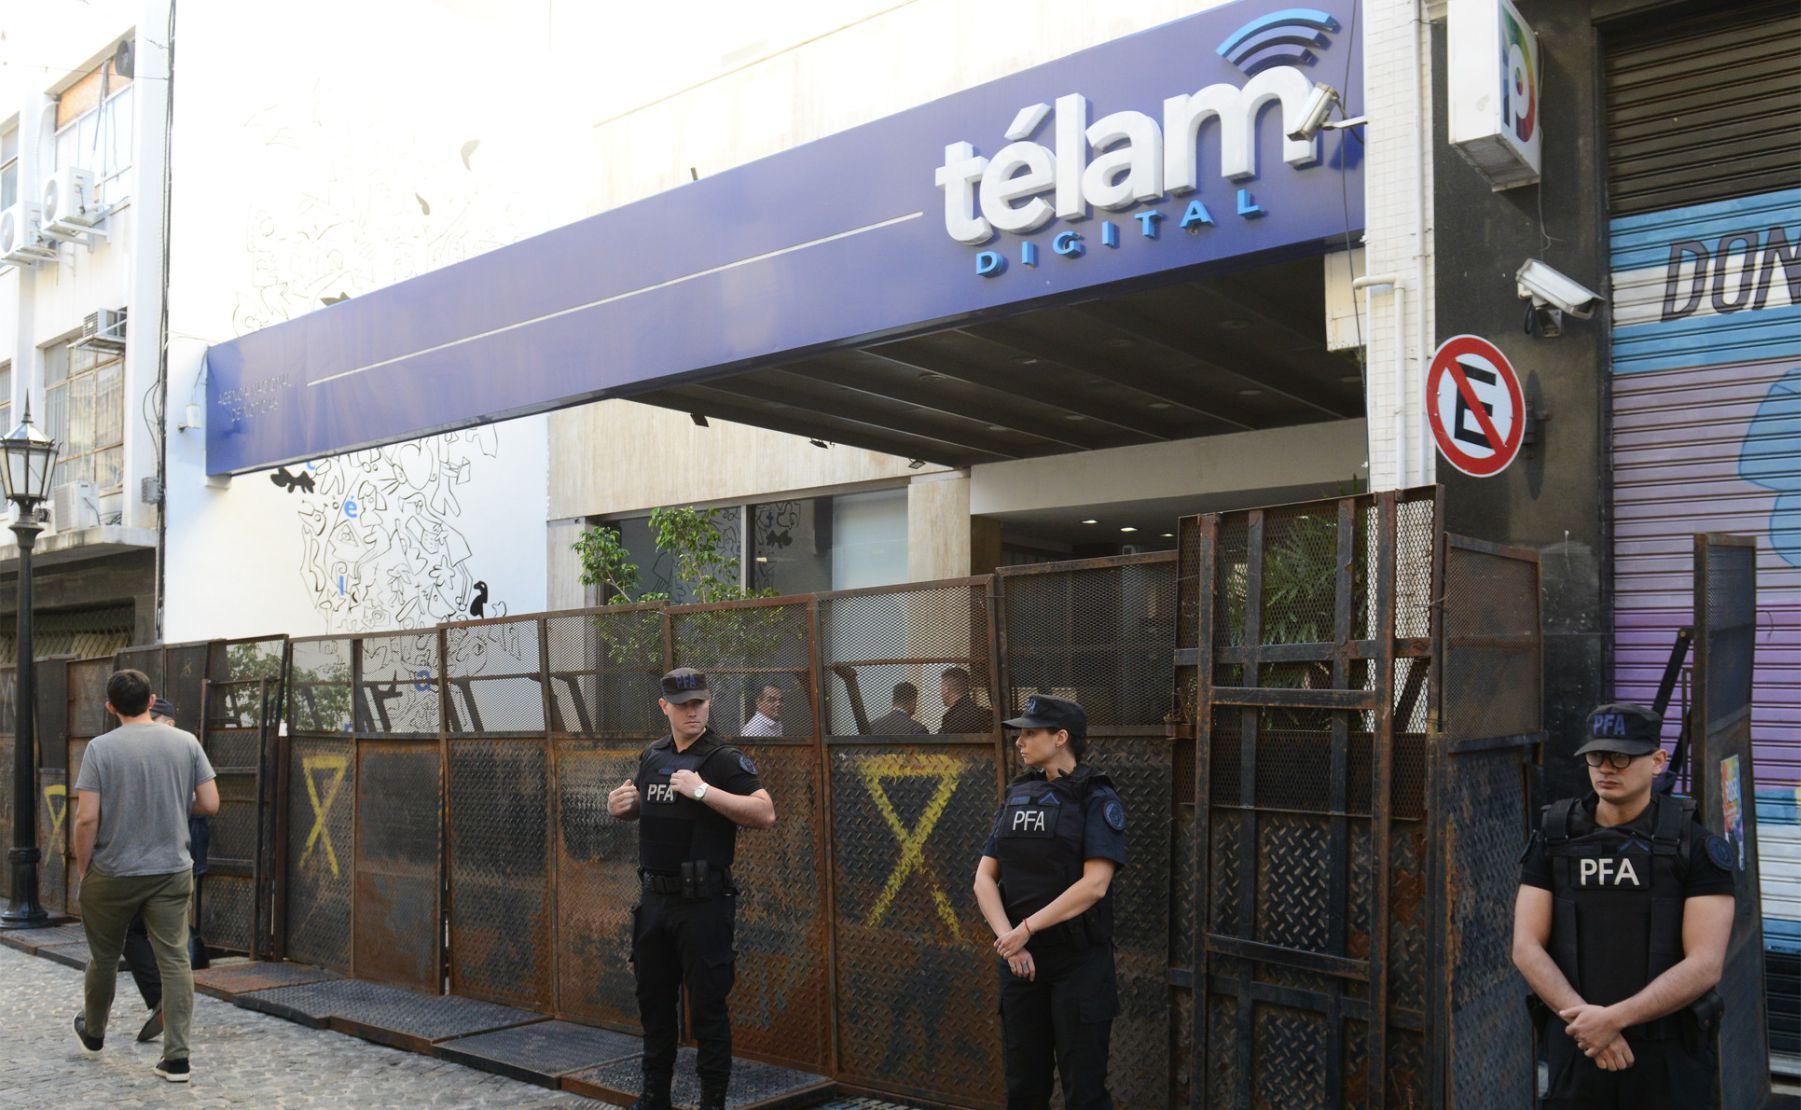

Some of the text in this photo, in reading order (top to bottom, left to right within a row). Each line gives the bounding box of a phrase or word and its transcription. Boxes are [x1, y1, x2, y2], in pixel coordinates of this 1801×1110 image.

[935, 65, 1318, 247] télam
[975, 188, 1266, 278] DIGITAL
[1454, 361, 1497, 449] E
[675, 674, 696, 689] PFA
[1593, 713, 1627, 737] PFA
[646, 783, 674, 802] PFA
[1012, 810, 1046, 832] PFA
[1579, 857, 1641, 887] PFA
